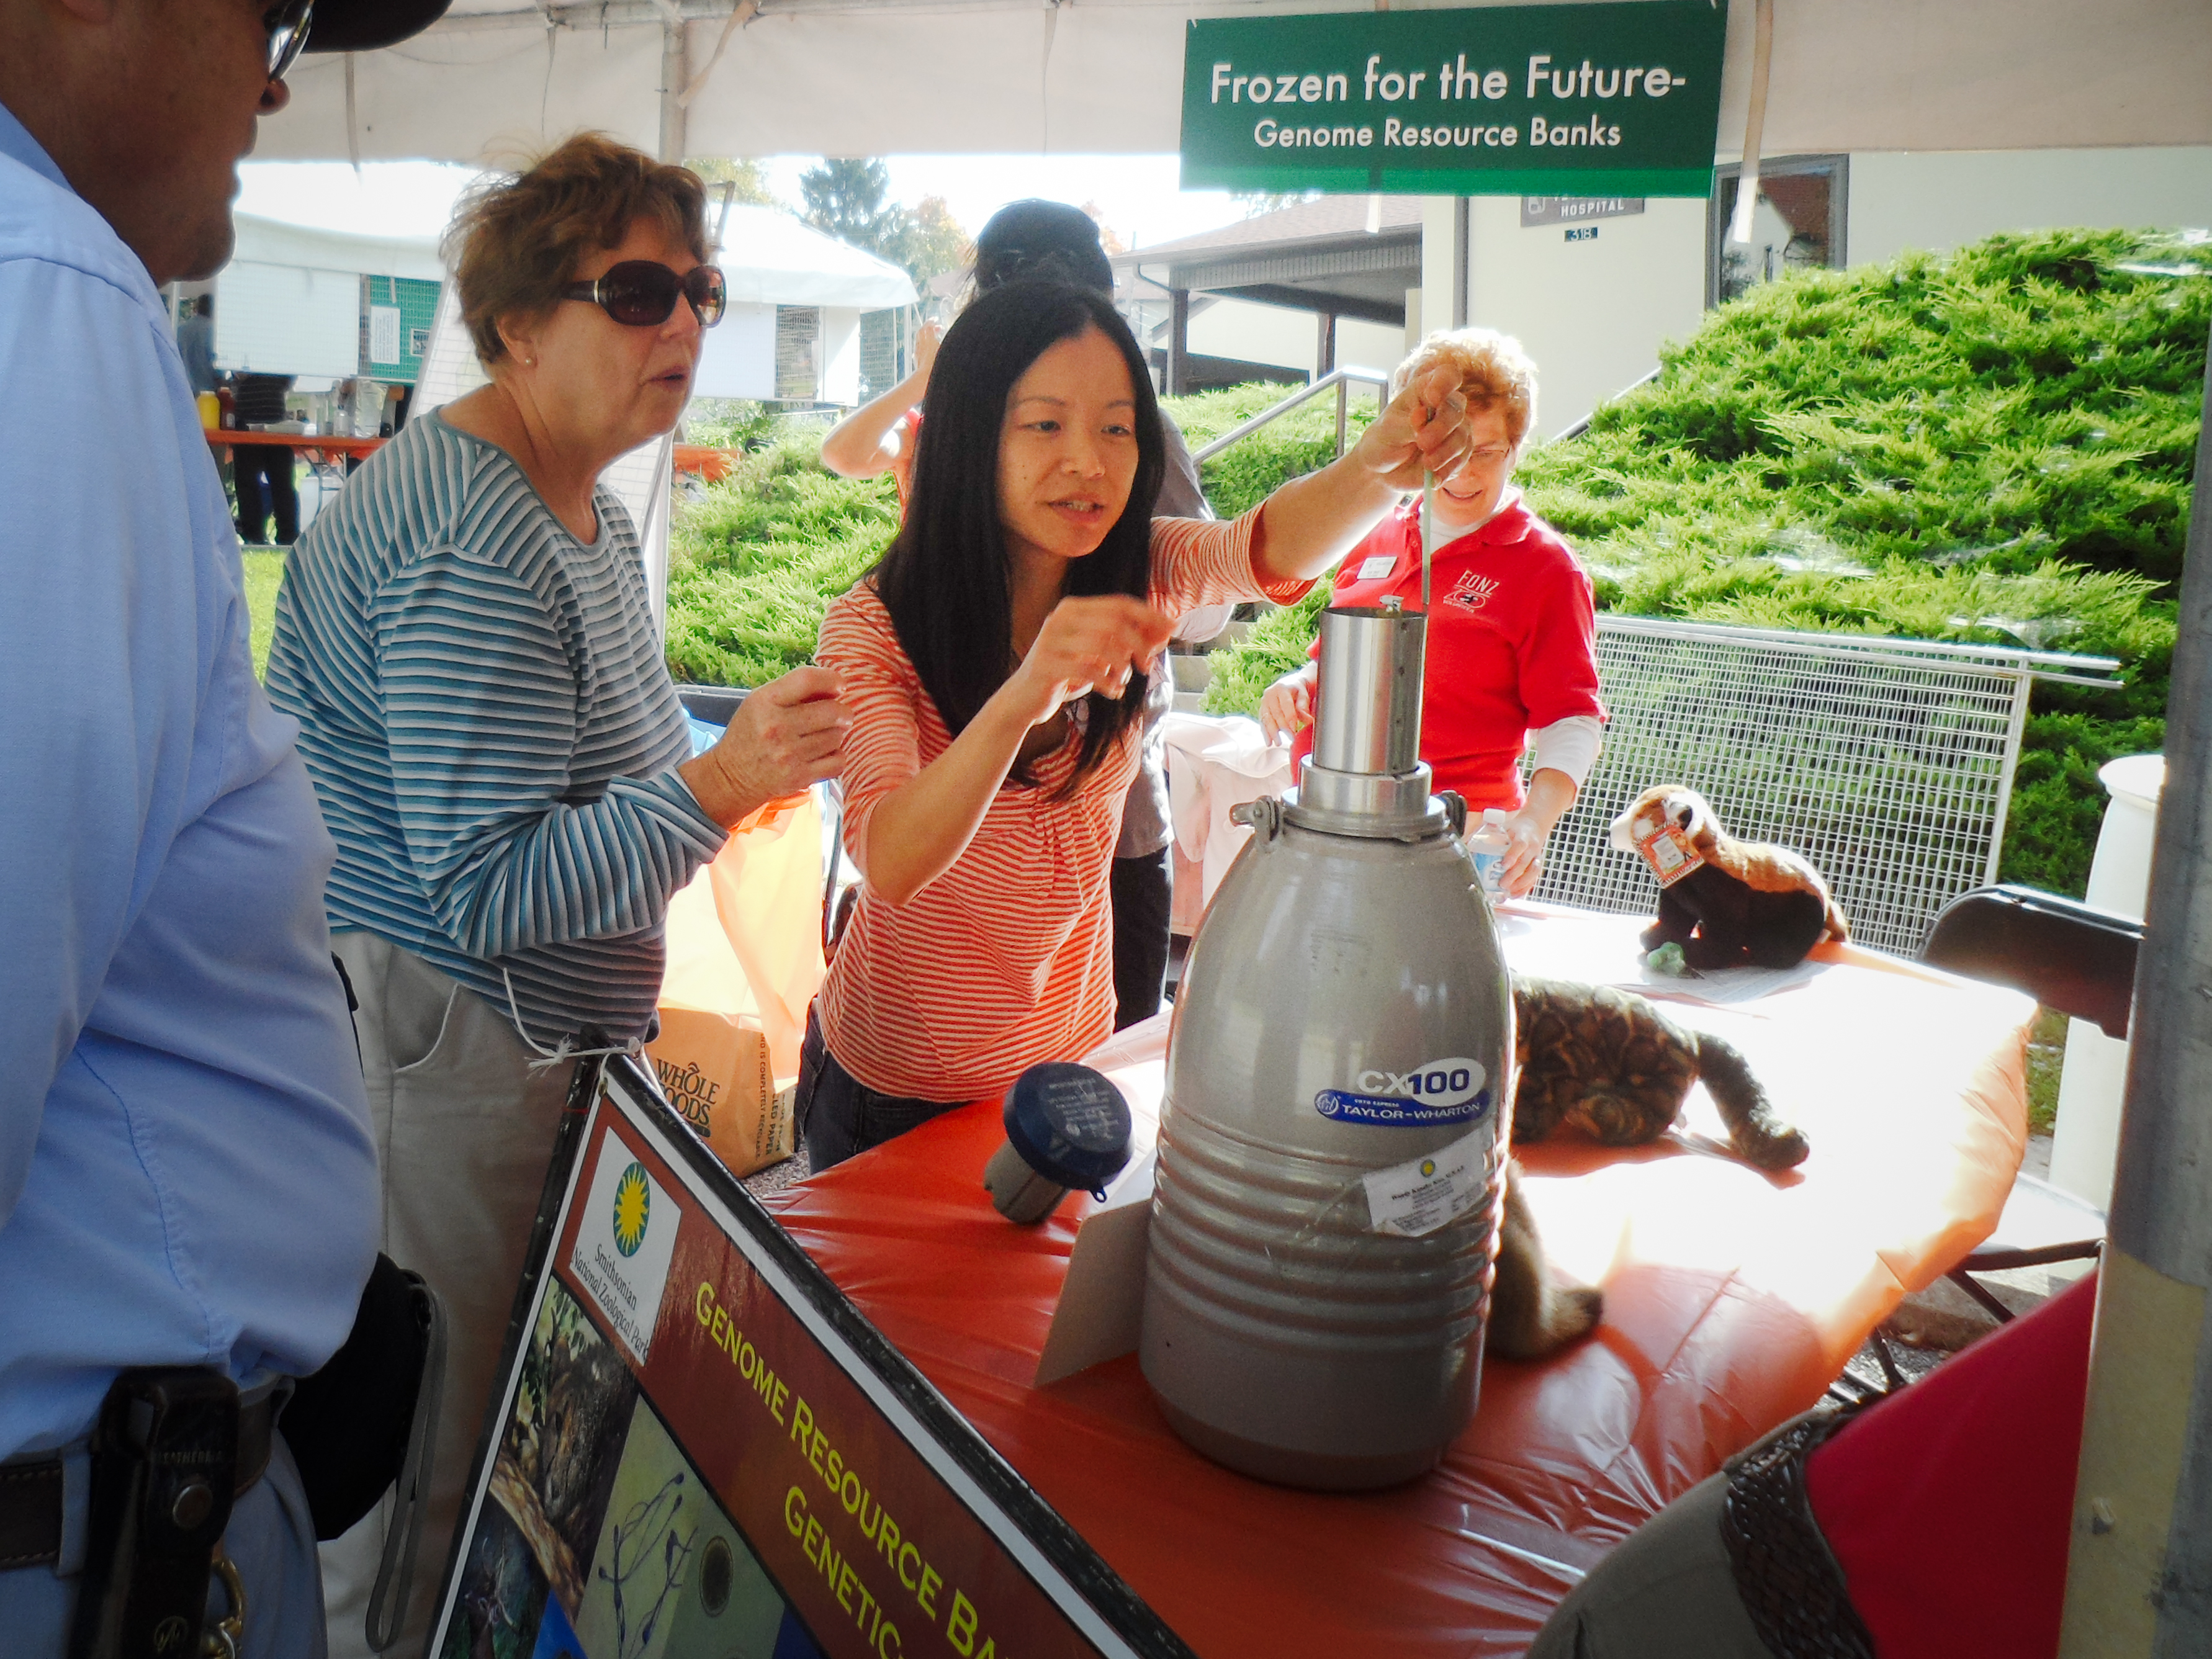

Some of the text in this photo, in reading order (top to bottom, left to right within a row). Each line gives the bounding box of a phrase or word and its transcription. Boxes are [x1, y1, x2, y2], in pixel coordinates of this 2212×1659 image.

[1211, 53, 1686, 104] Frozen for the Future-
[1254, 113, 1621, 148] Genome Resource Banks
[1561, 198, 1625, 217] HOSPITAL
[1570, 228, 1591, 241] 318
[1457, 570, 1499, 595] FONZ
[657, 1058, 721, 1105] WHOLE
[1357, 1068, 1470, 1095] CX100
[660, 1083, 711, 1126] OODS
[765, 1123, 776, 1155] PAPER
[595, 1243, 637, 1311] Smithsonian
[572, 1247, 649, 1360] National Zoological Park
[696, 1282, 789, 1427] GENOME
[790, 1395, 943, 1622] RESOURCE
